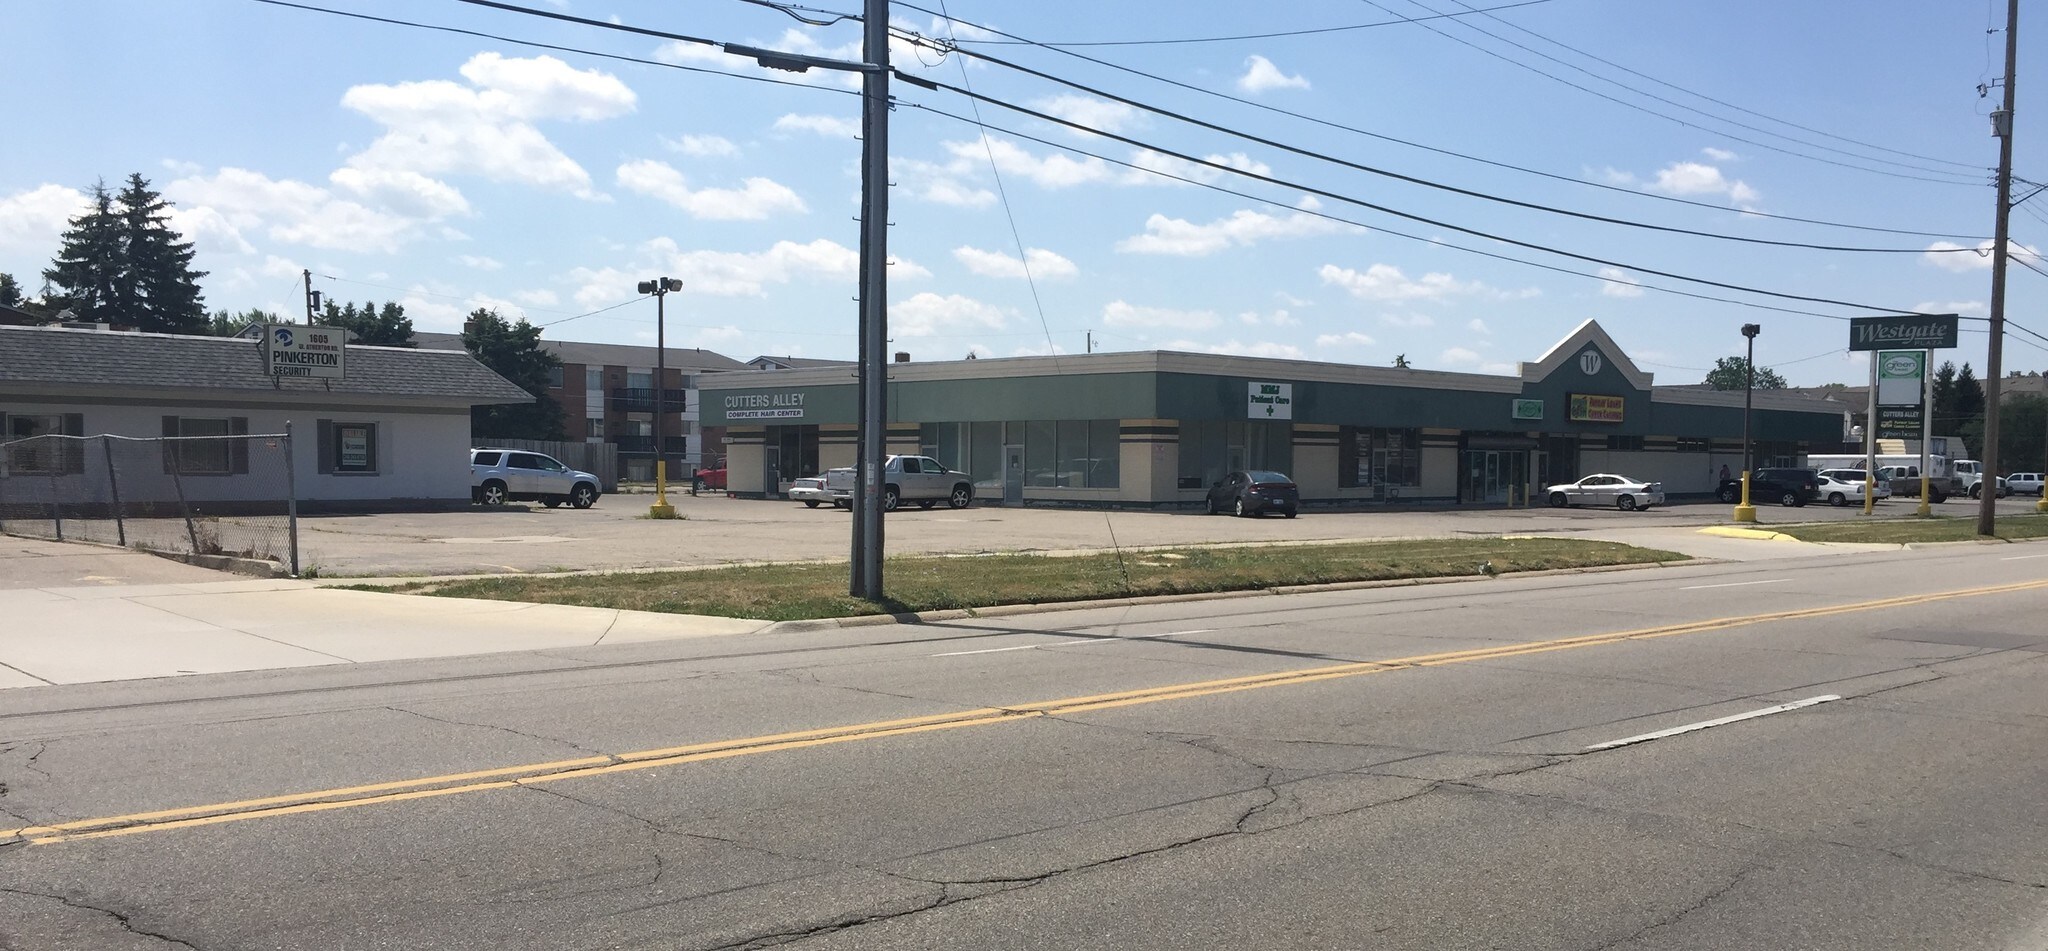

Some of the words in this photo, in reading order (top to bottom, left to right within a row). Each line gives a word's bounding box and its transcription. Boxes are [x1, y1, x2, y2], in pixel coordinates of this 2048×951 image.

[1852, 323, 1947, 344] Westgate
[273, 351, 338, 365] PINKERTON
[1582, 354, 1598, 372] W
[273, 366, 312, 376] SECURITY
[725, 394, 770, 408] CUTTERS
[773, 393, 805, 406] ALLEY
[1250, 395, 1274, 403] Patient
[1275, 396, 1290, 404] Care
